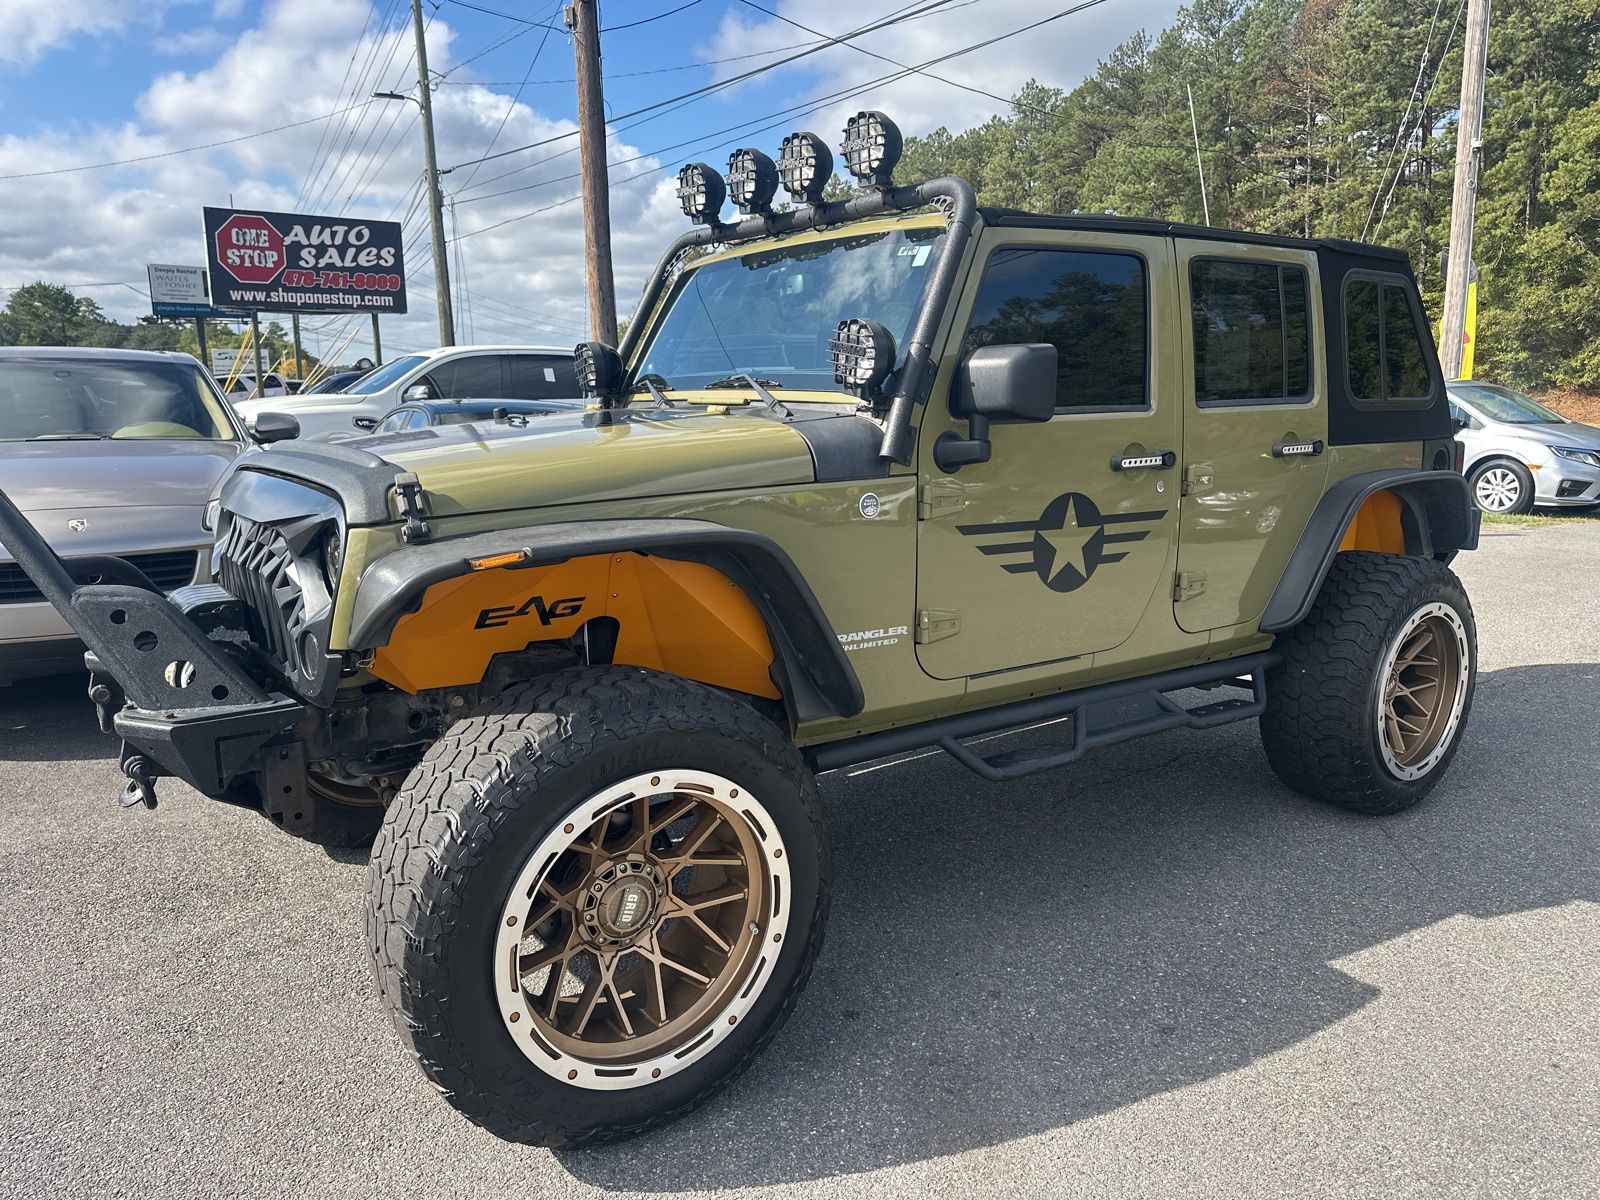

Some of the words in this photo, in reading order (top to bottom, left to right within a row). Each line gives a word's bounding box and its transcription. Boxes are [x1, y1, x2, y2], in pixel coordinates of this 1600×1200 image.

[231, 228, 269, 247] ONE
[283, 225, 370, 246] AUTO
[227, 249, 278, 268] STOP
[299, 247, 395, 268] SALES
[281, 269, 400, 291] 478-741-8009
[230, 288, 393, 308] www.shoponestop.com
[474, 596, 586, 629] EAG
[837, 626, 908, 643] RANGLER
[621, 894, 638, 922] GRID
